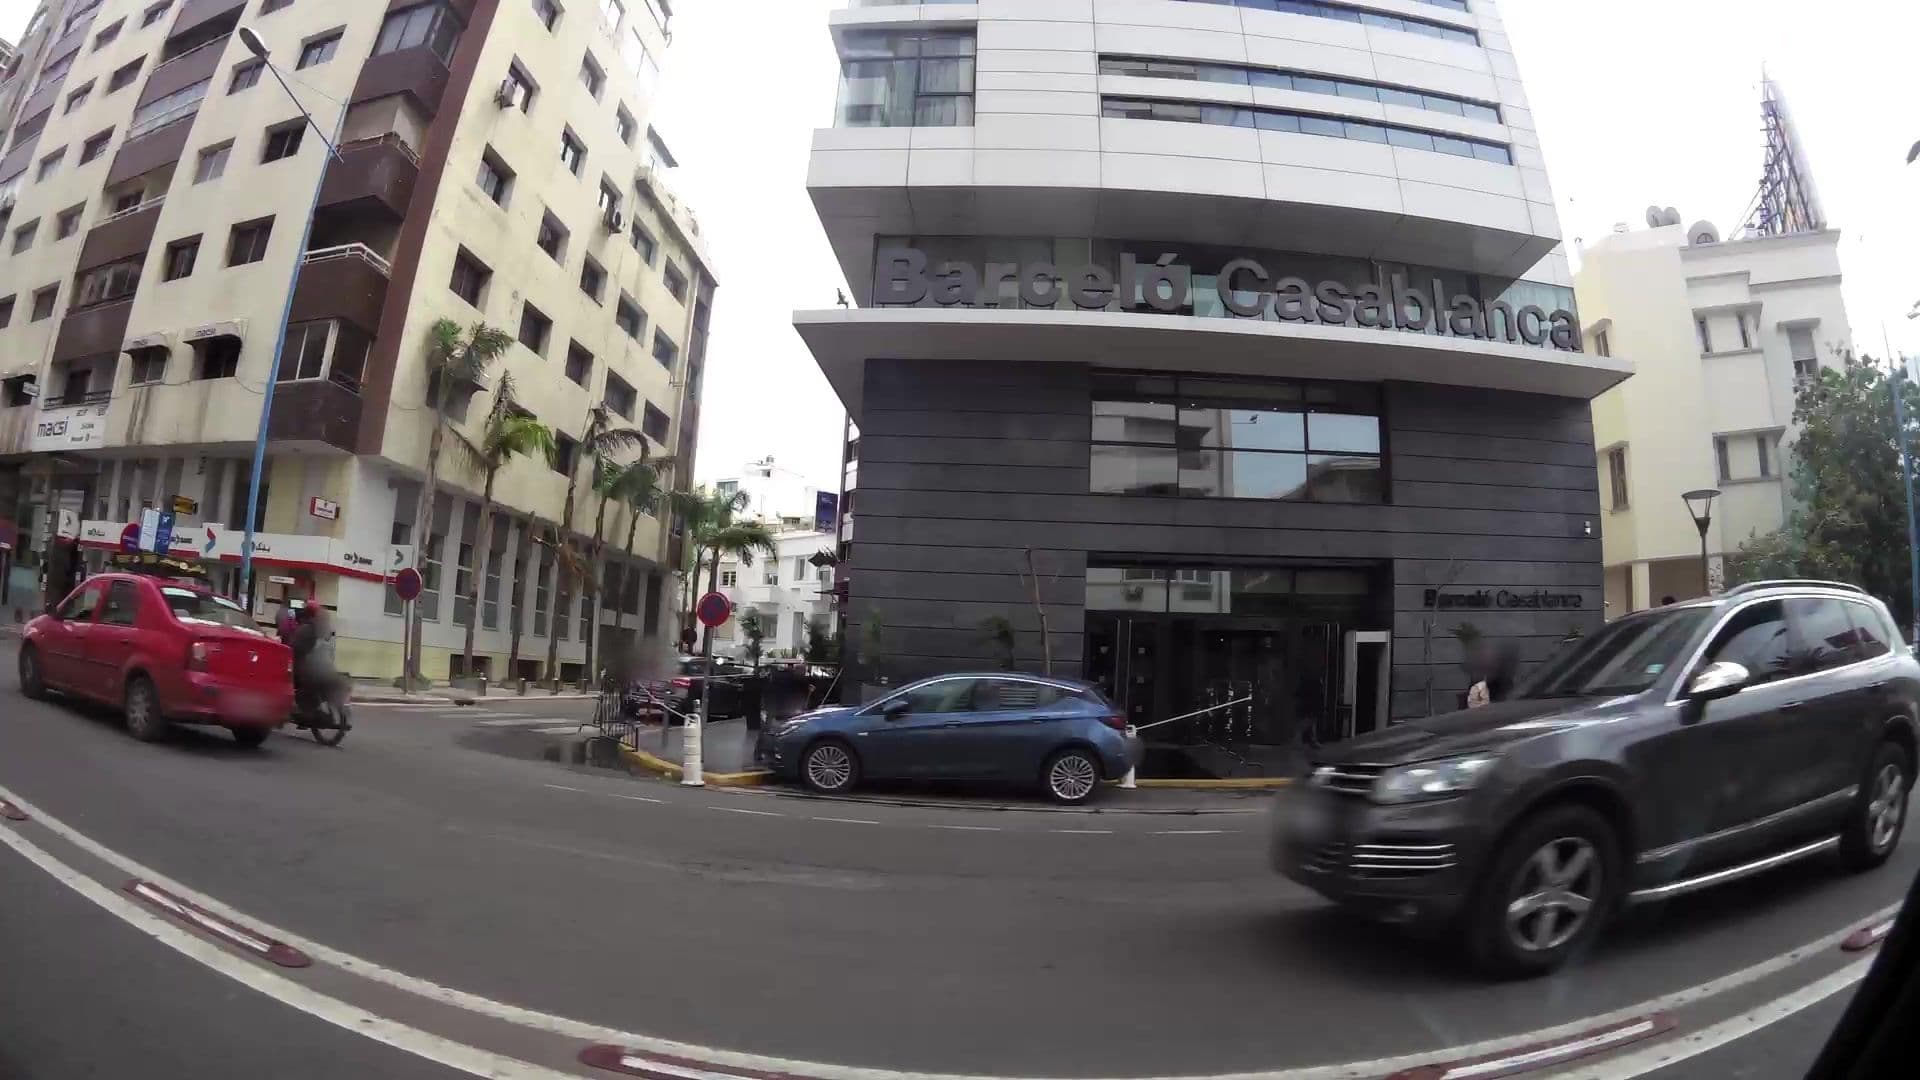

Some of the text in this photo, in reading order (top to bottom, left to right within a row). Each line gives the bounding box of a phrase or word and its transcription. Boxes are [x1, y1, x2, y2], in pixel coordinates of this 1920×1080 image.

[878, 247, 1584, 352] Barceló Casablanca
[37, 416, 69, 438] macsi
